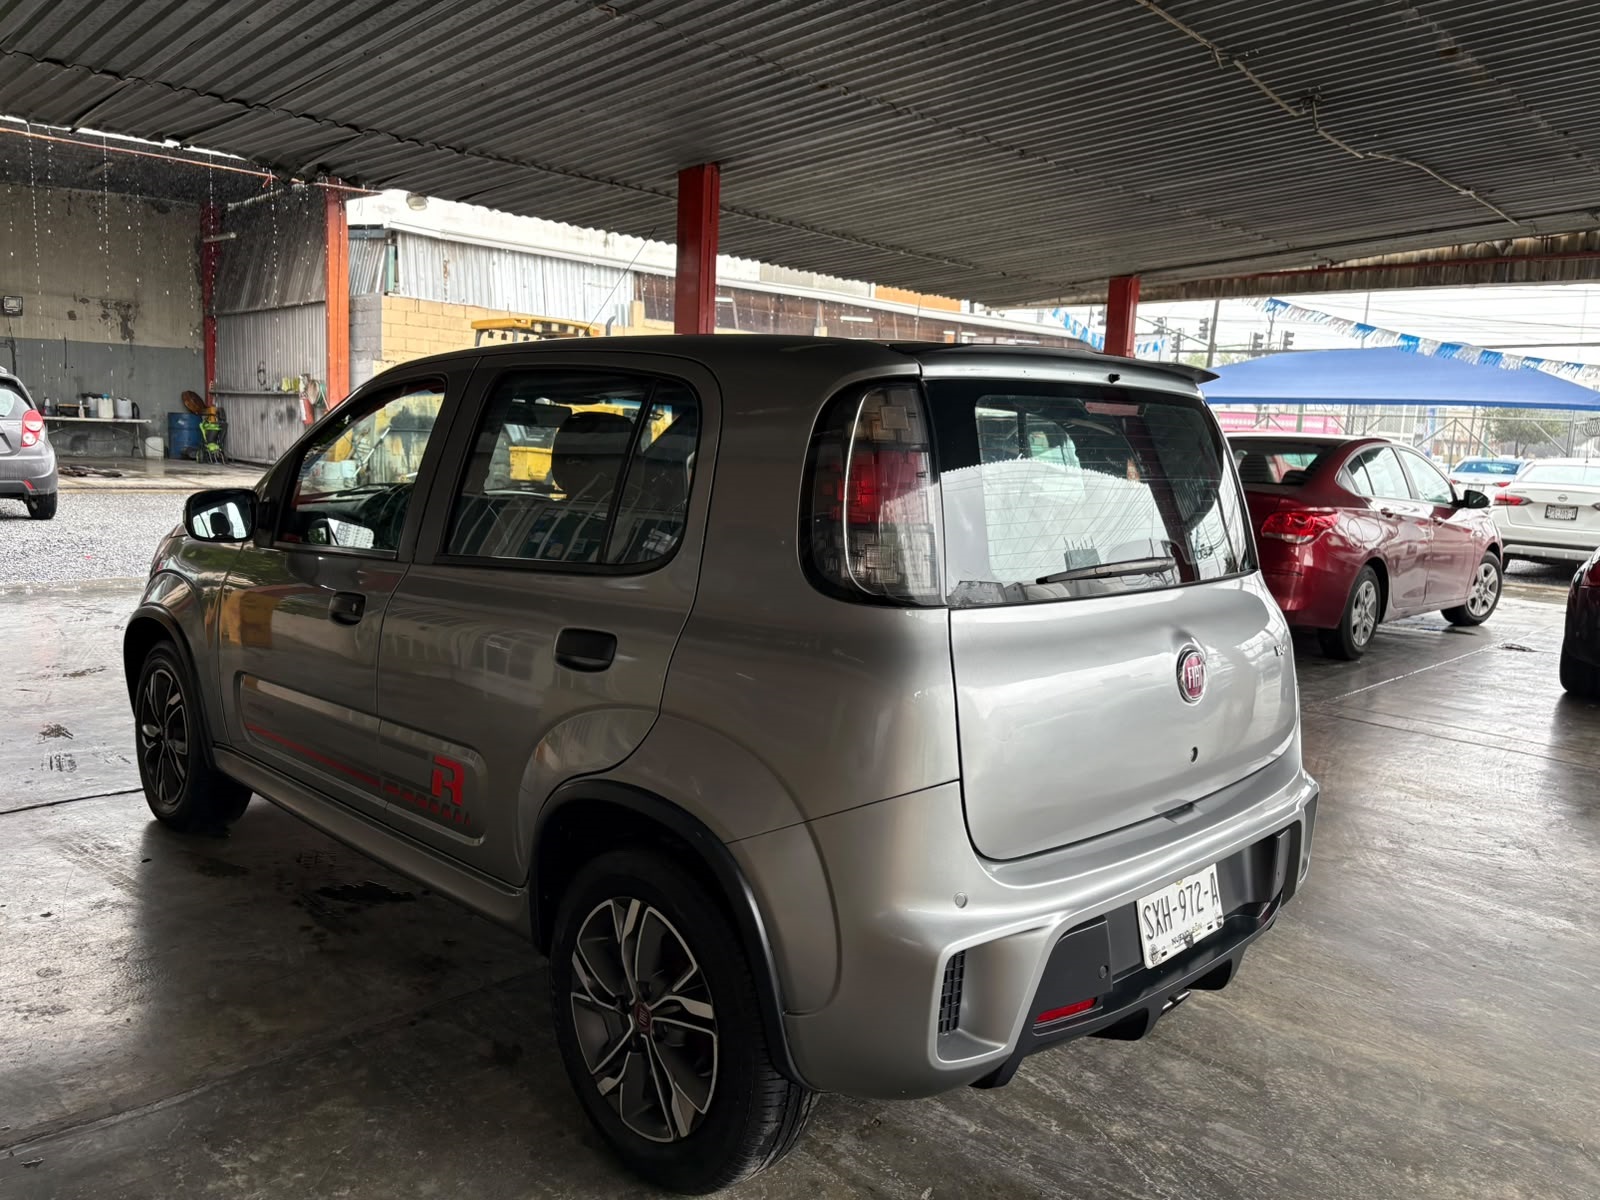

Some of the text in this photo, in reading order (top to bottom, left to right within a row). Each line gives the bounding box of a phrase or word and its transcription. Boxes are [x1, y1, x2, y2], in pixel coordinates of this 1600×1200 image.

[1187, 664, 1203, 690] FIAT
[431, 754, 465, 807] R
[1142, 872, 1219, 941] SXH-972-A
